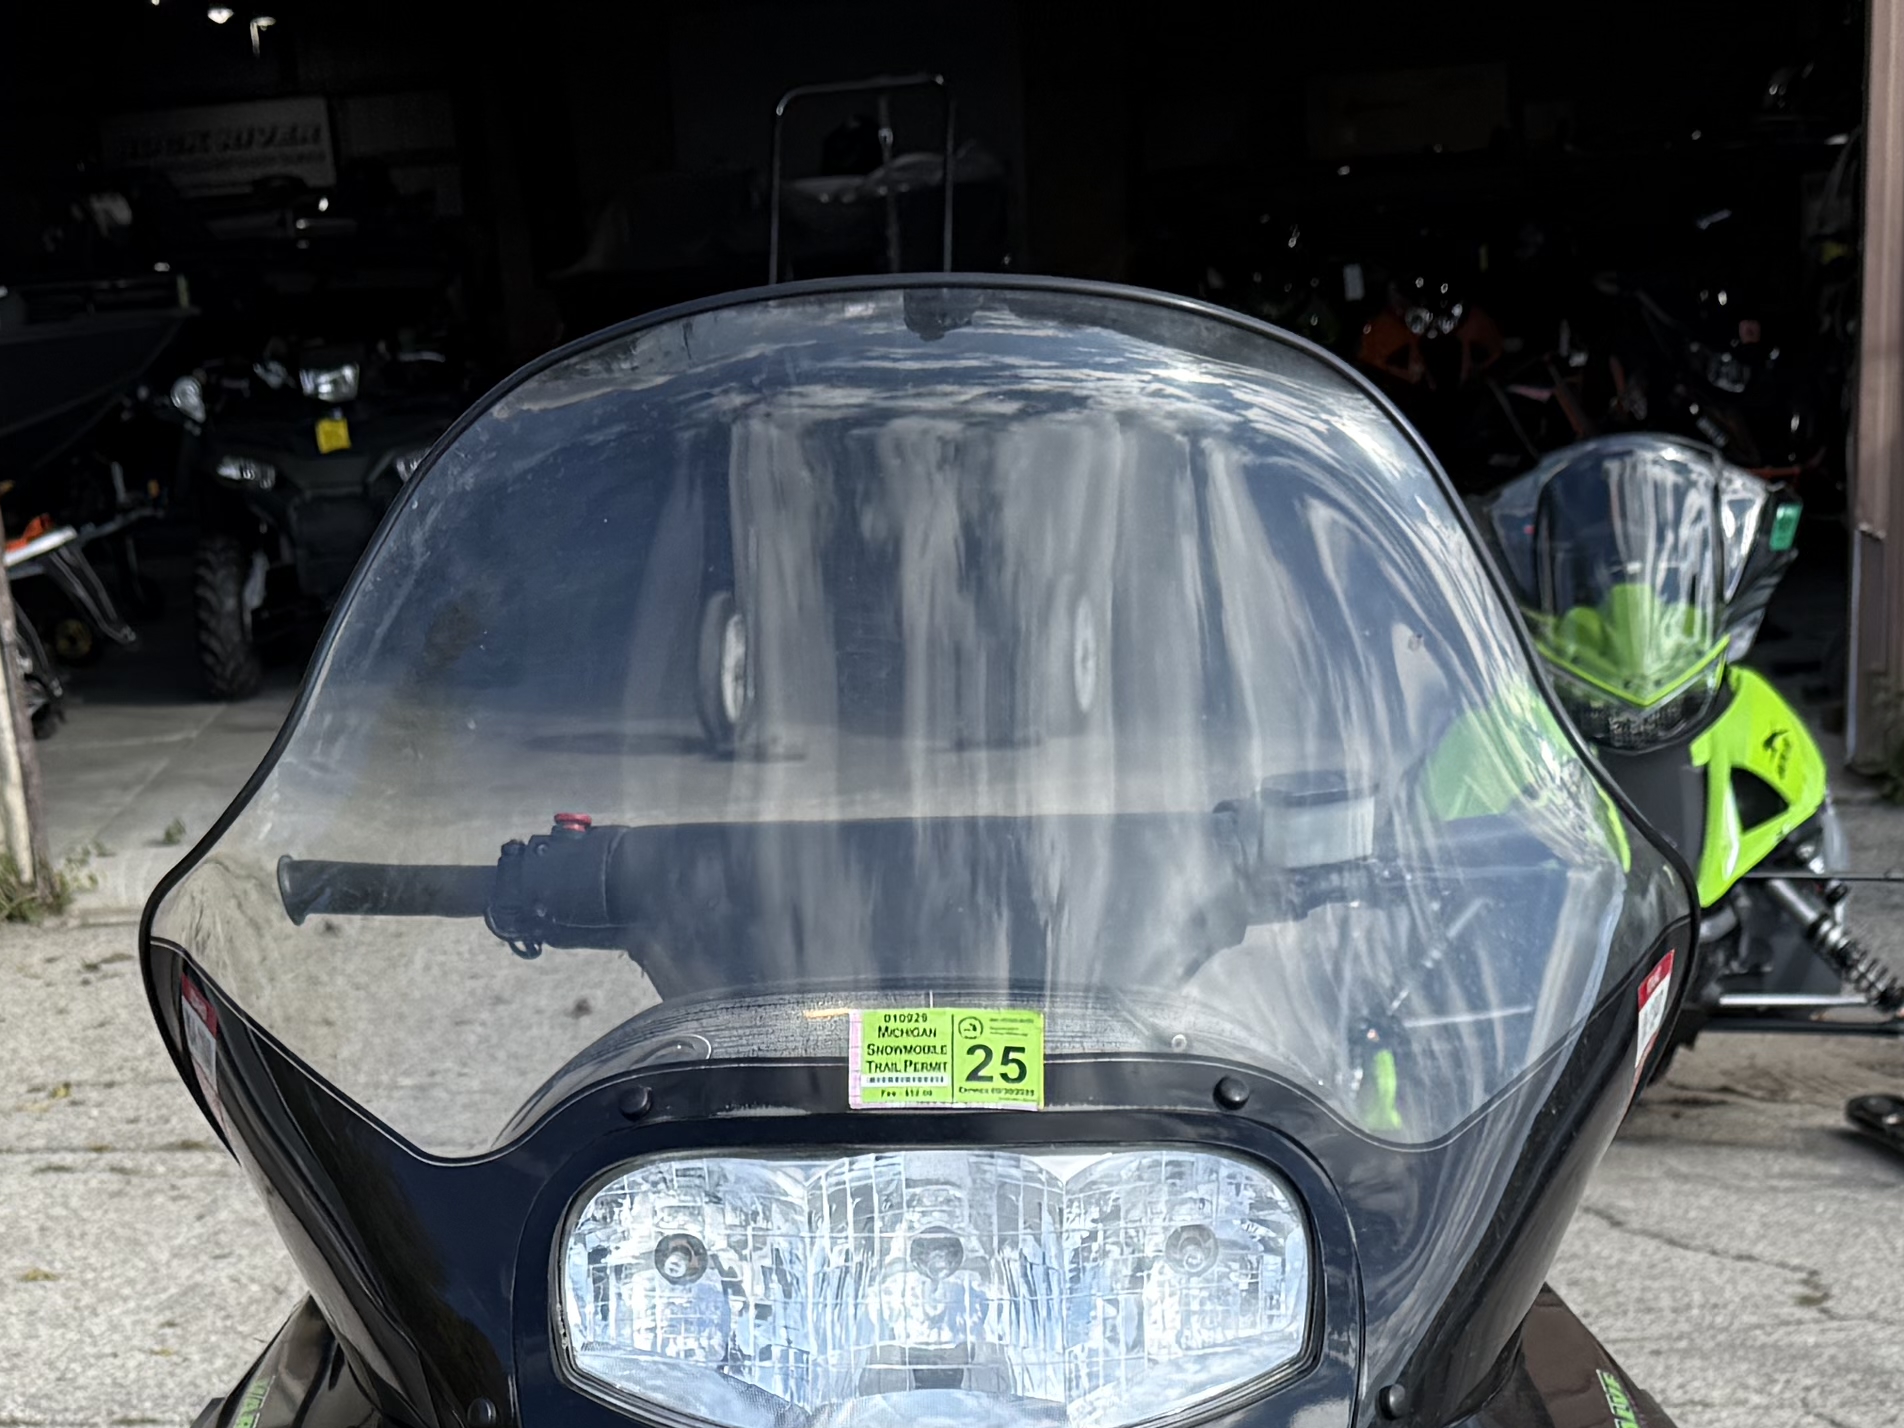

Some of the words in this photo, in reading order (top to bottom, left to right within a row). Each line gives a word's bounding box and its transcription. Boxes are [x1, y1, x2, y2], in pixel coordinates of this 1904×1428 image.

[877, 1025, 937, 1039] MICHIGAN
[867, 1043, 948, 1056] SNOWMOBILE
[865, 1060, 901, 1074] TRAIL
[903, 1059, 948, 1073] PERMIT
[965, 1044, 1028, 1084] 25
